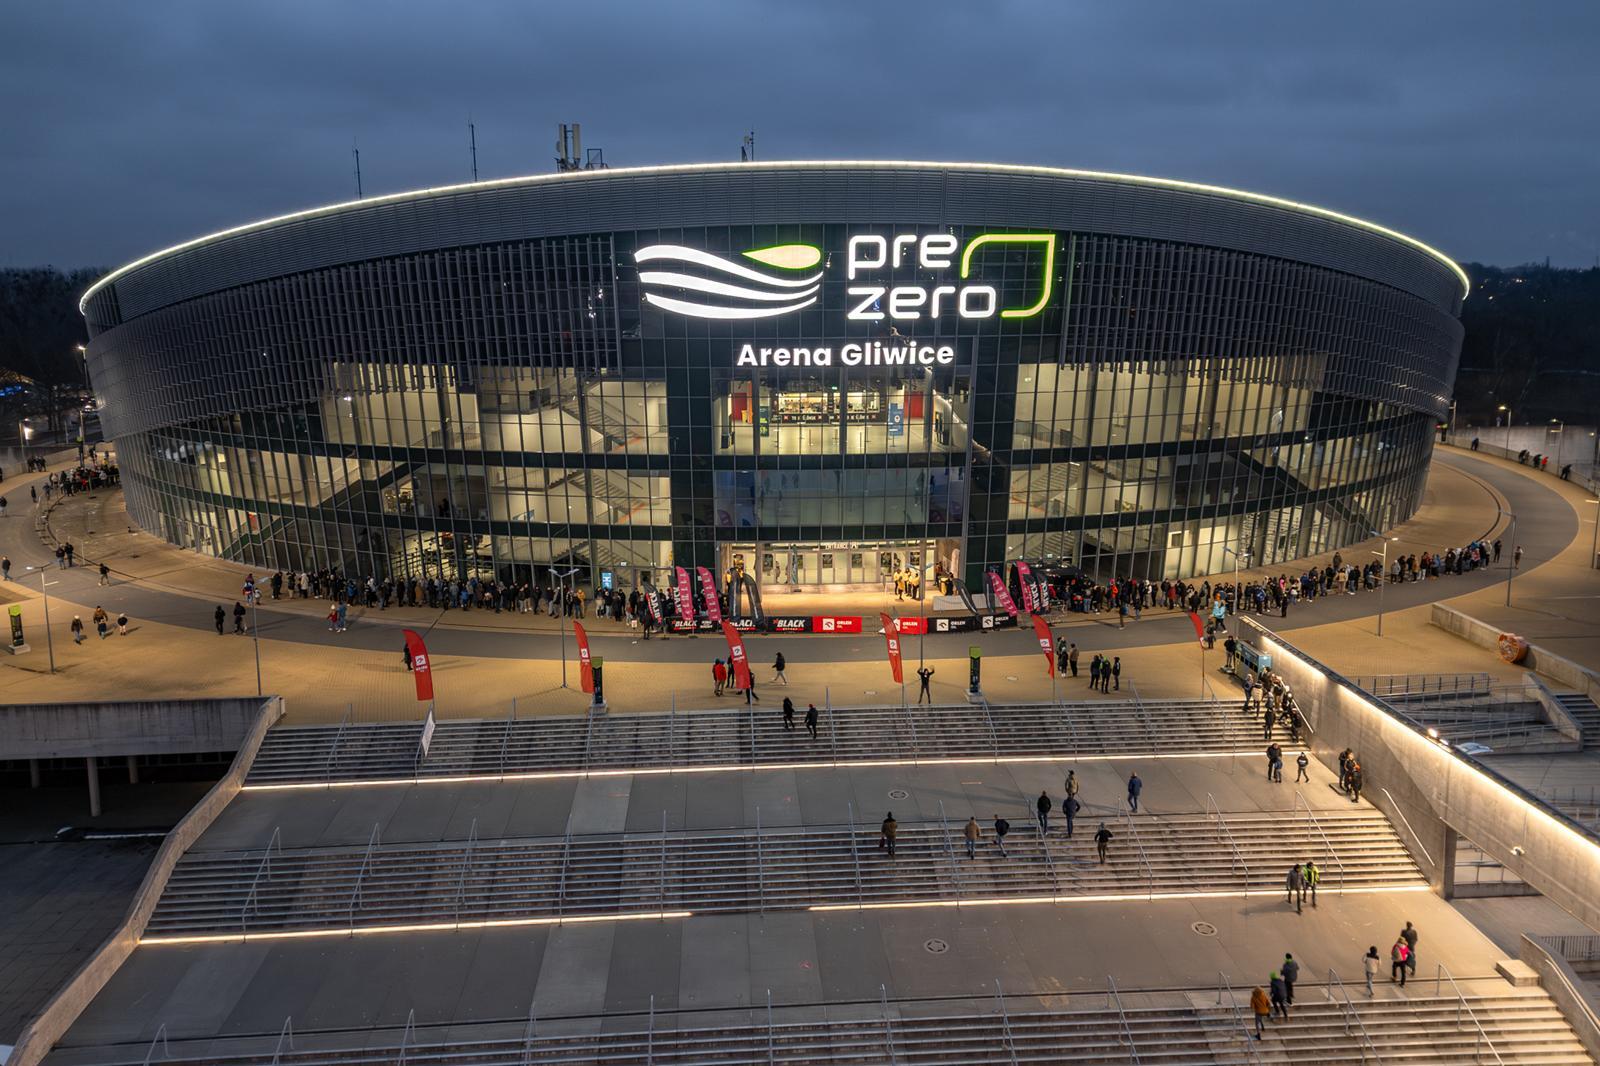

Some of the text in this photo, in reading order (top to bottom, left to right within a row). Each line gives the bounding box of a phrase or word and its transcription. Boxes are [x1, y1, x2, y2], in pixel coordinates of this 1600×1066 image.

[848, 233, 958, 280] pre
[847, 285, 997, 320] zero
[737, 341, 955, 367] Arena Gliwice
[777, 619, 806, 628] BLACK
